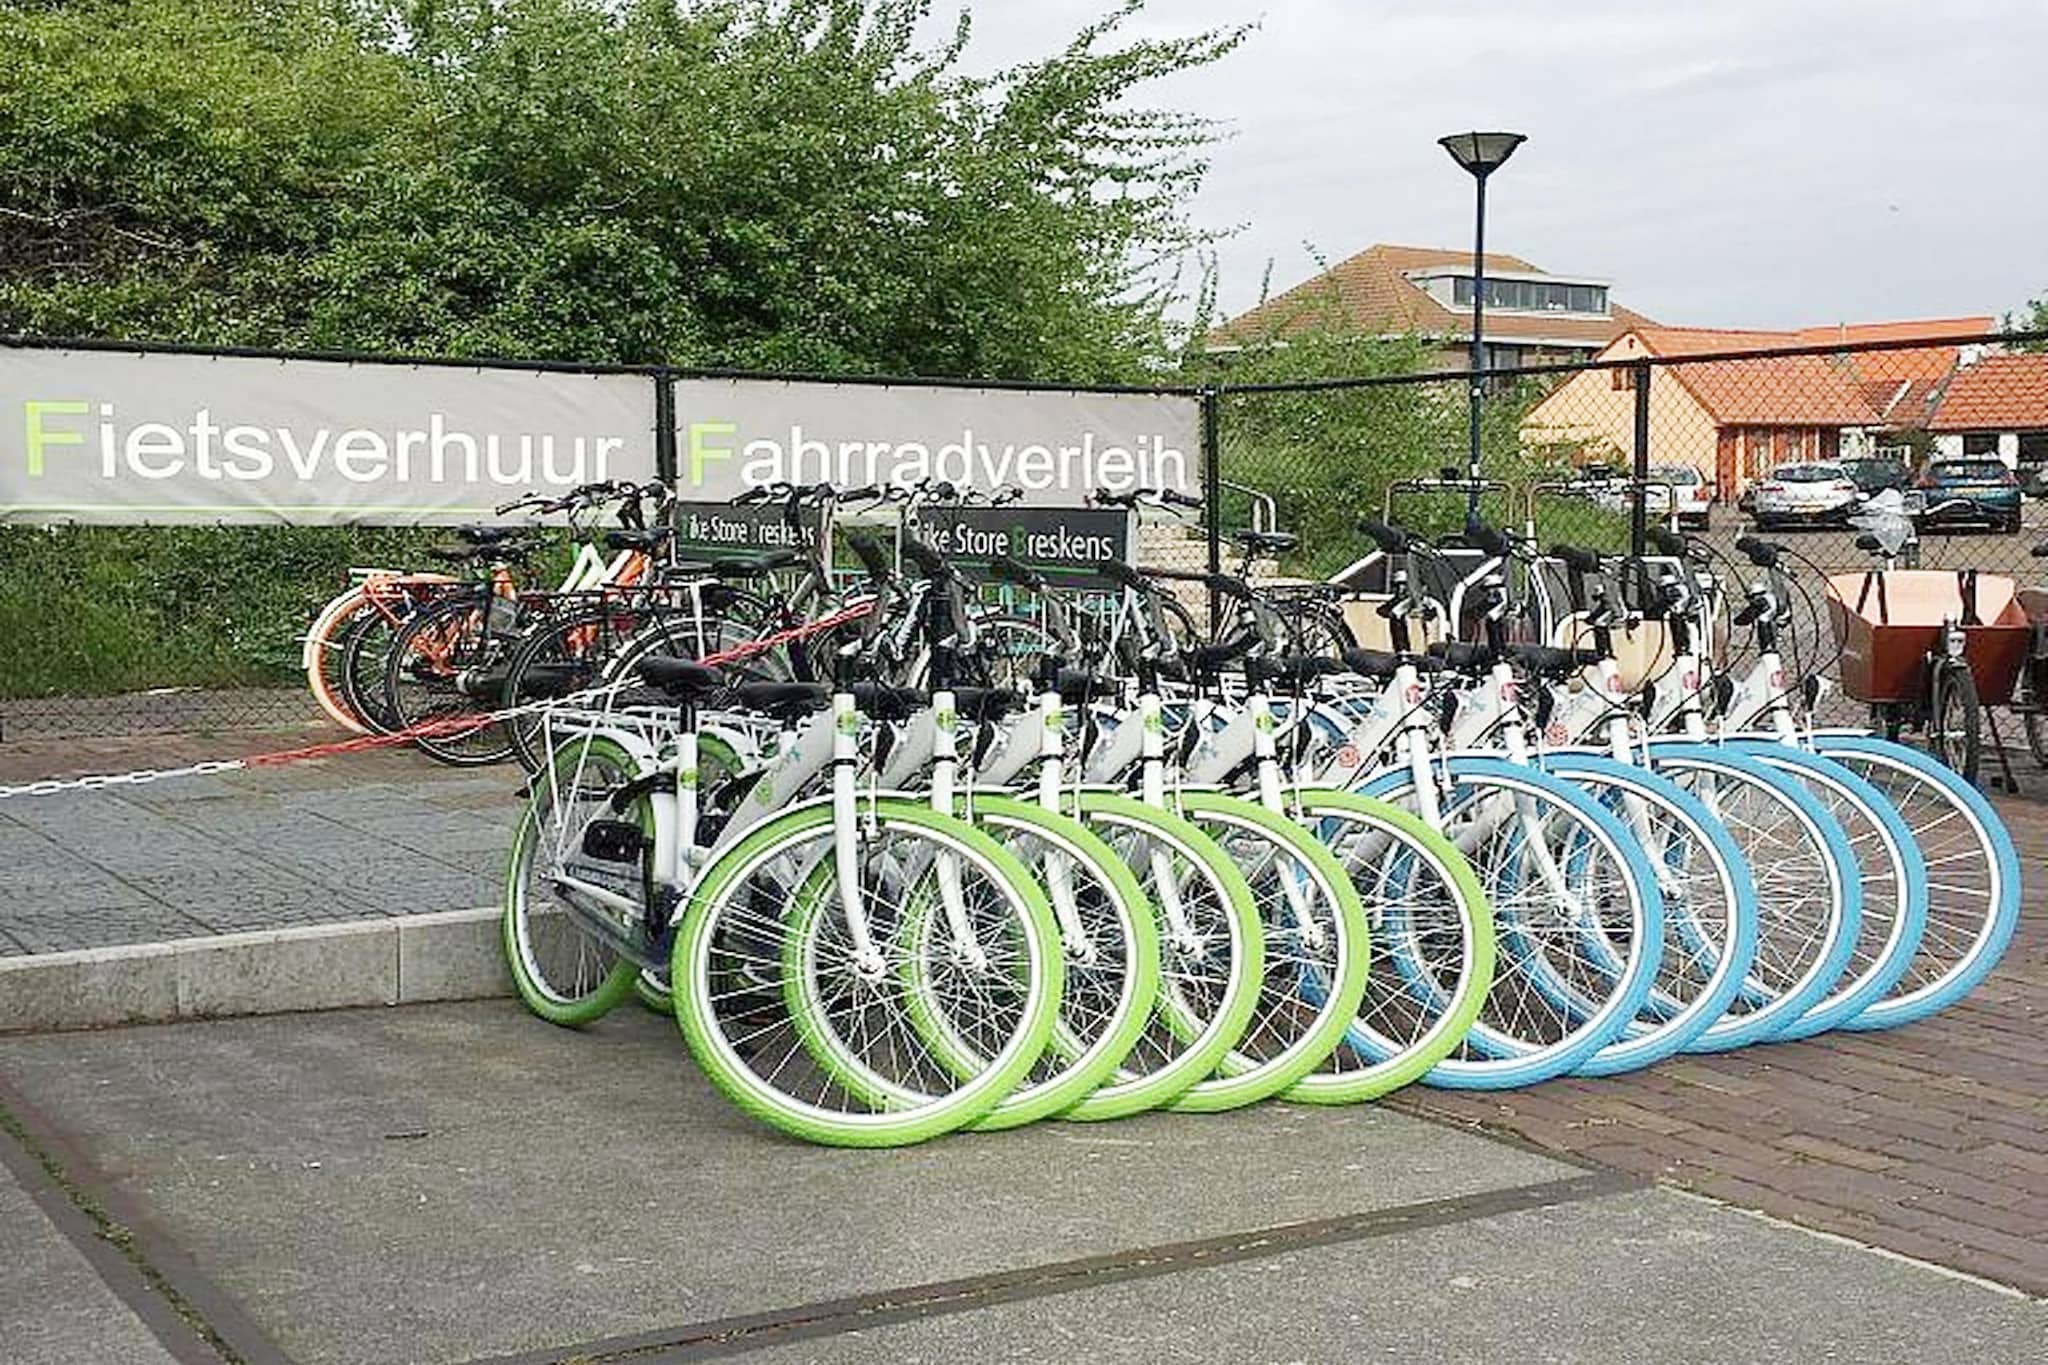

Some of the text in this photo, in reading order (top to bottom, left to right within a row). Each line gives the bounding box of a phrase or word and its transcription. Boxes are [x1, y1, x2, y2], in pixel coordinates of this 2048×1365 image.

[24, 401, 622, 484] Fietsverhuur
[687, 423, 1187, 491] Fahrradverleih
[955, 522, 1009, 556] Store
[1013, 524, 1115, 561] Breskens
